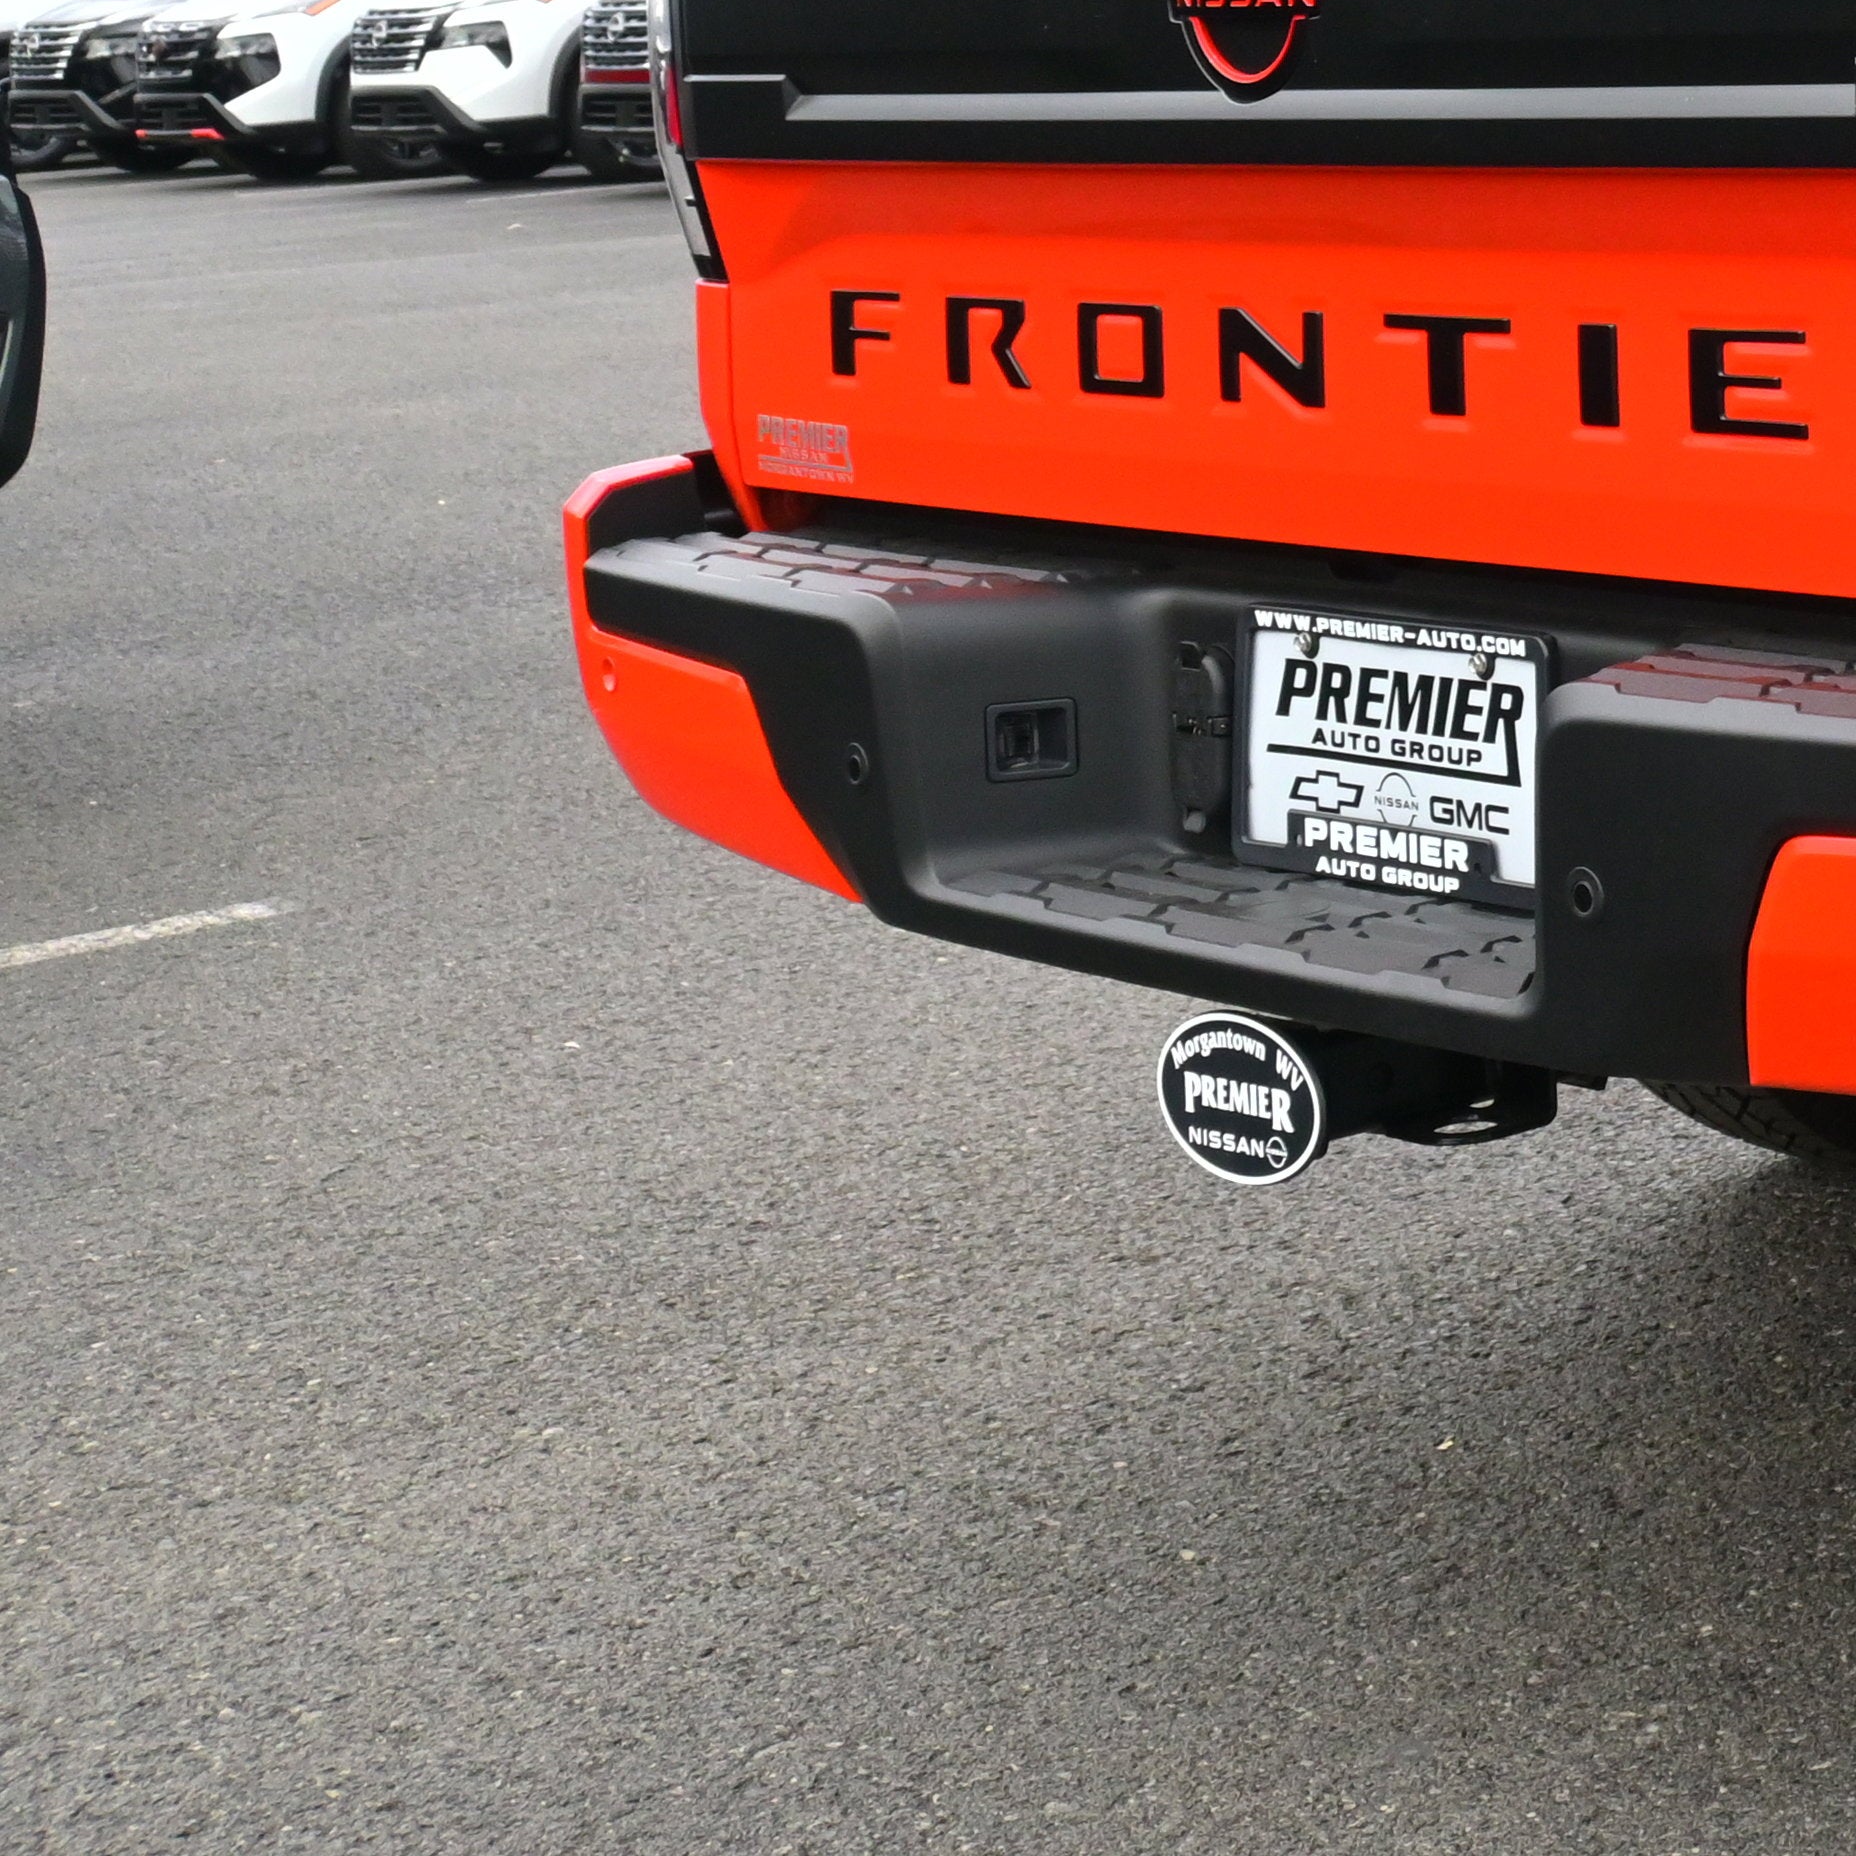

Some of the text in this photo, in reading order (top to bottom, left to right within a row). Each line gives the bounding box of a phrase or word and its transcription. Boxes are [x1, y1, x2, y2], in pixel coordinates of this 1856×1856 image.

[757, 414, 850, 454] PREMIER
[1254, 610, 1526, 657] WWW.PREMIER-AUTO.COM
[1275, 658, 1524, 746] PREMIER
[1311, 727, 1483, 767] AUTO GROUP
[1373, 795, 1420, 812] NISSAN
[1429, 796, 1511, 835] GMC
[1304, 817, 1469, 872] PREMIER
[1315, 856, 1460, 894] AUTO GROUP
[1170, 1028, 1305, 1092] Morgantown WV
[1184, 1071, 1295, 1133] PREMIER
[1188, 1125, 1265, 1159] NISSAN
